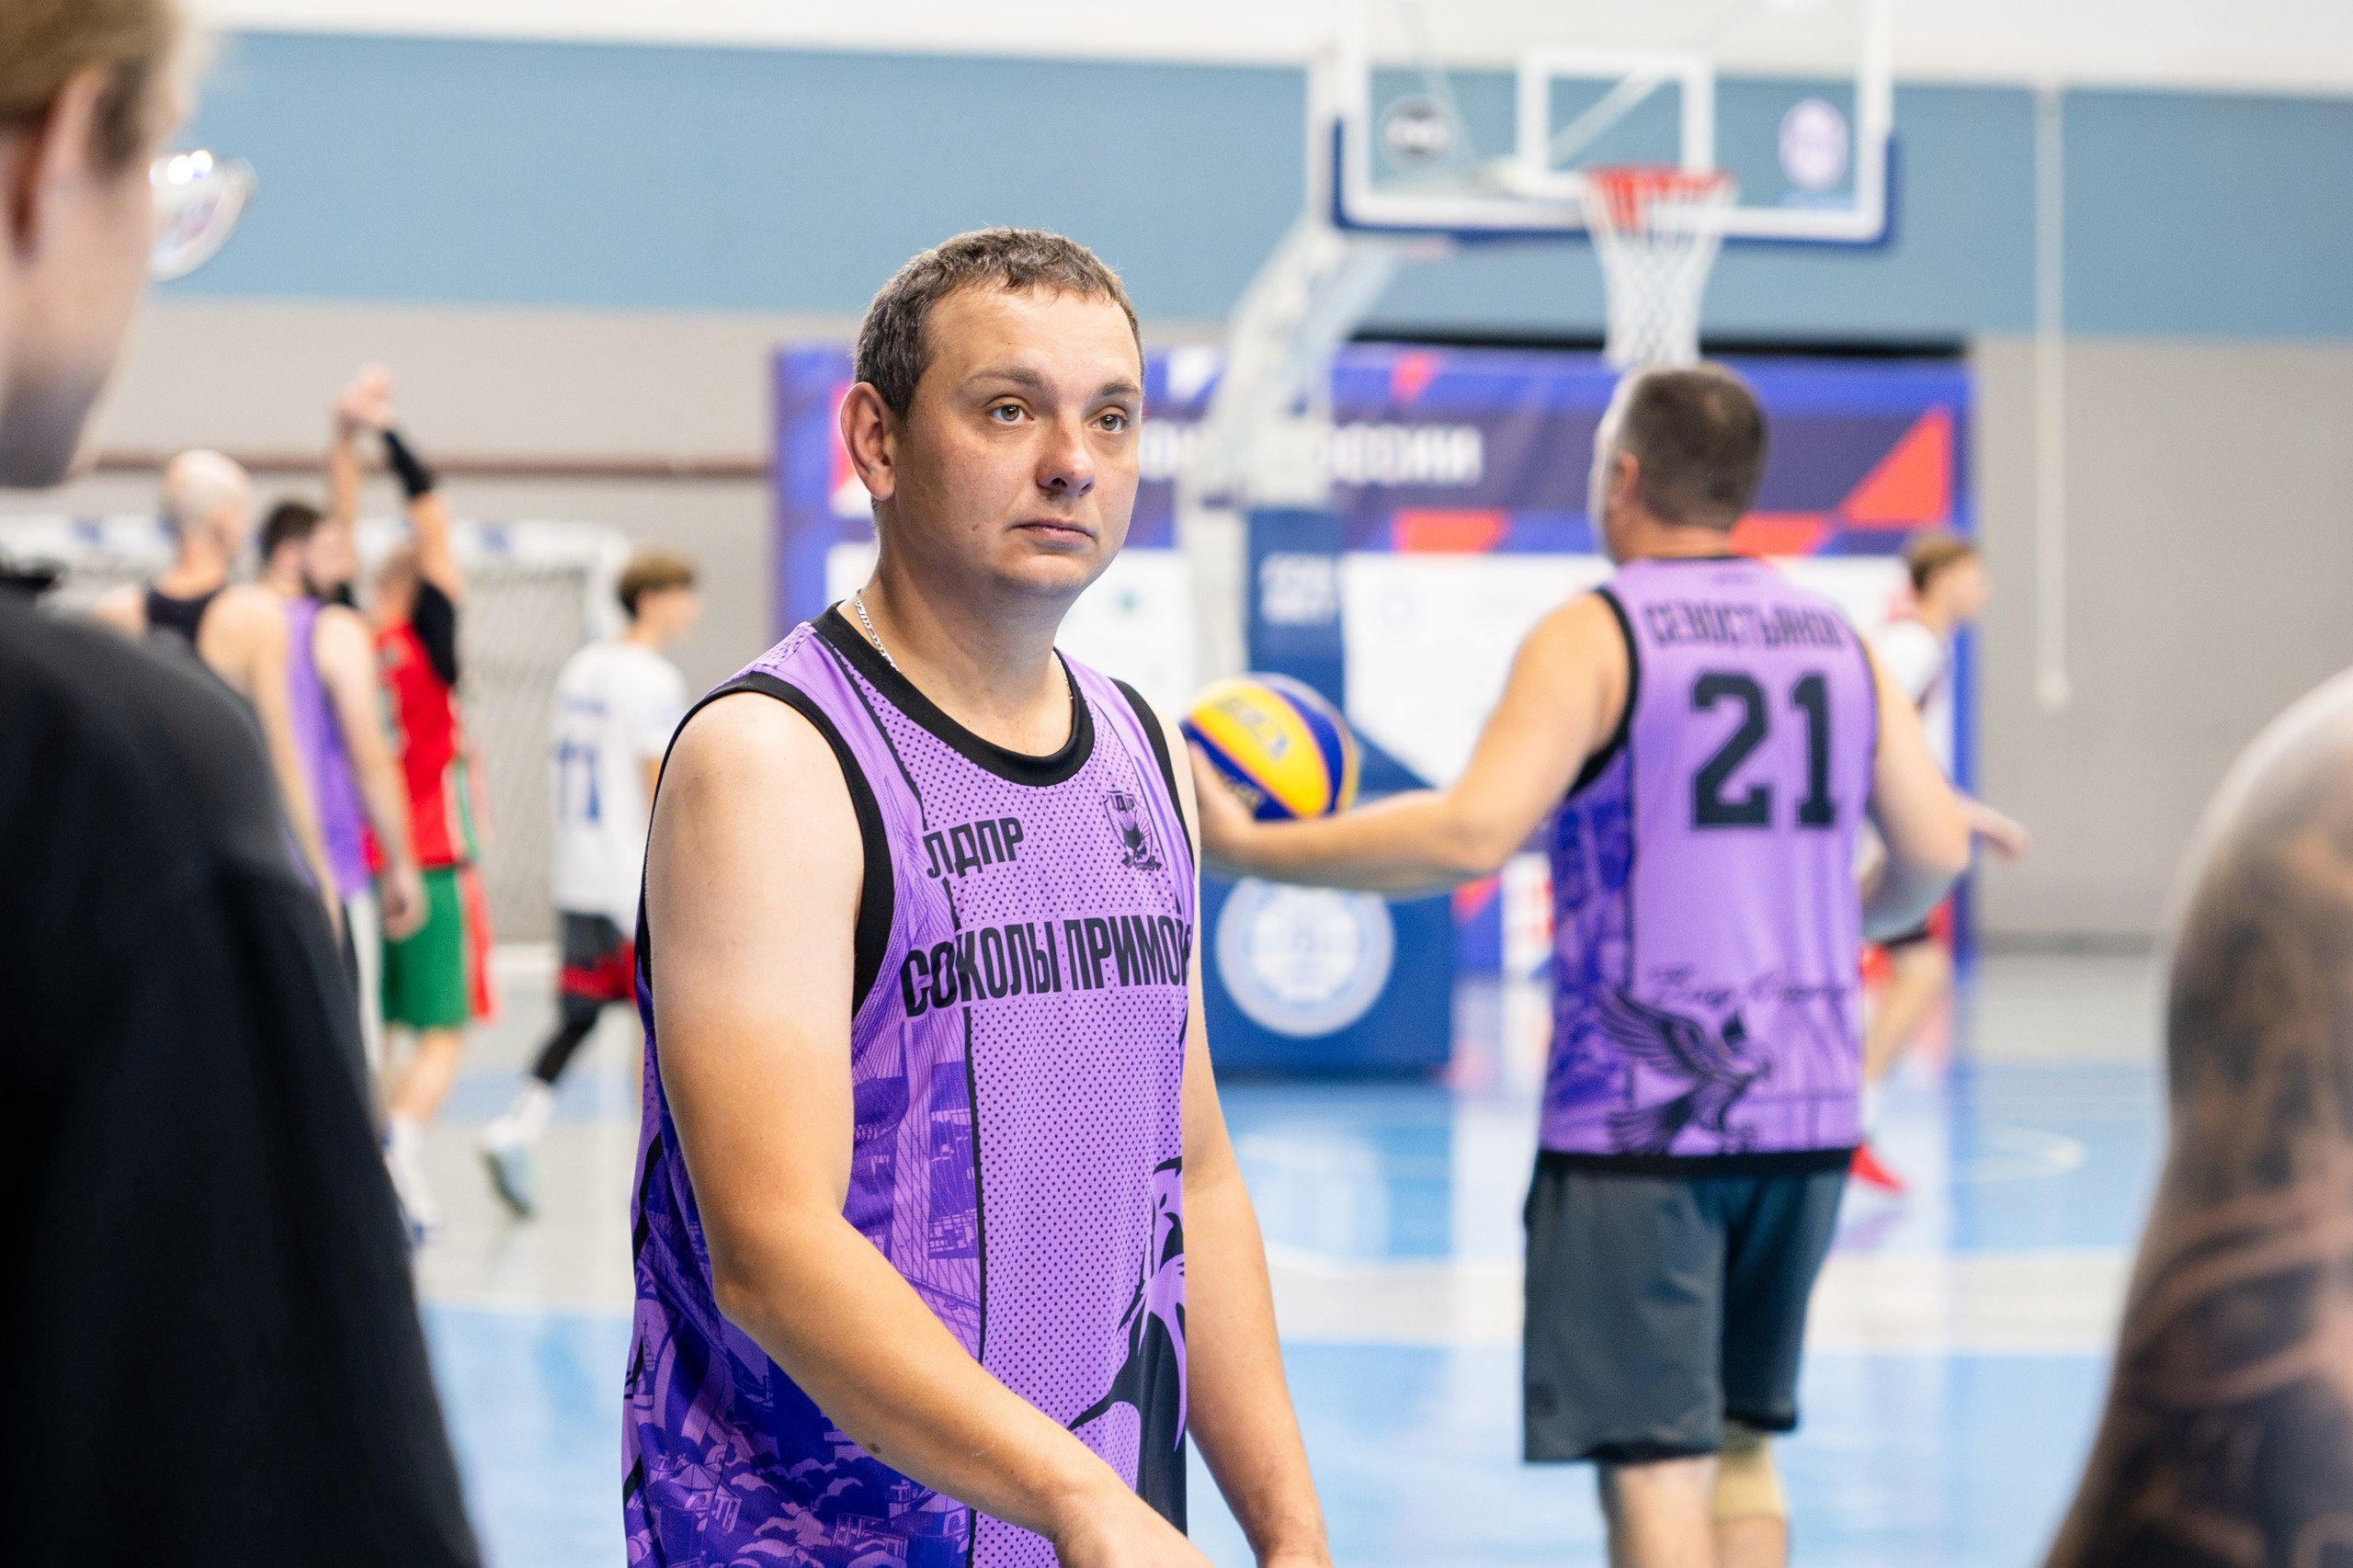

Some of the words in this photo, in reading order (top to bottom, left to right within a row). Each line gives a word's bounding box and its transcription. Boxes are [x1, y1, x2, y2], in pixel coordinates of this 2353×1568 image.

[1692, 671, 1836, 826] 21
[922, 816, 1025, 880] ЛДПР
[899, 920, 1063, 1018] СОКОЛЫ
